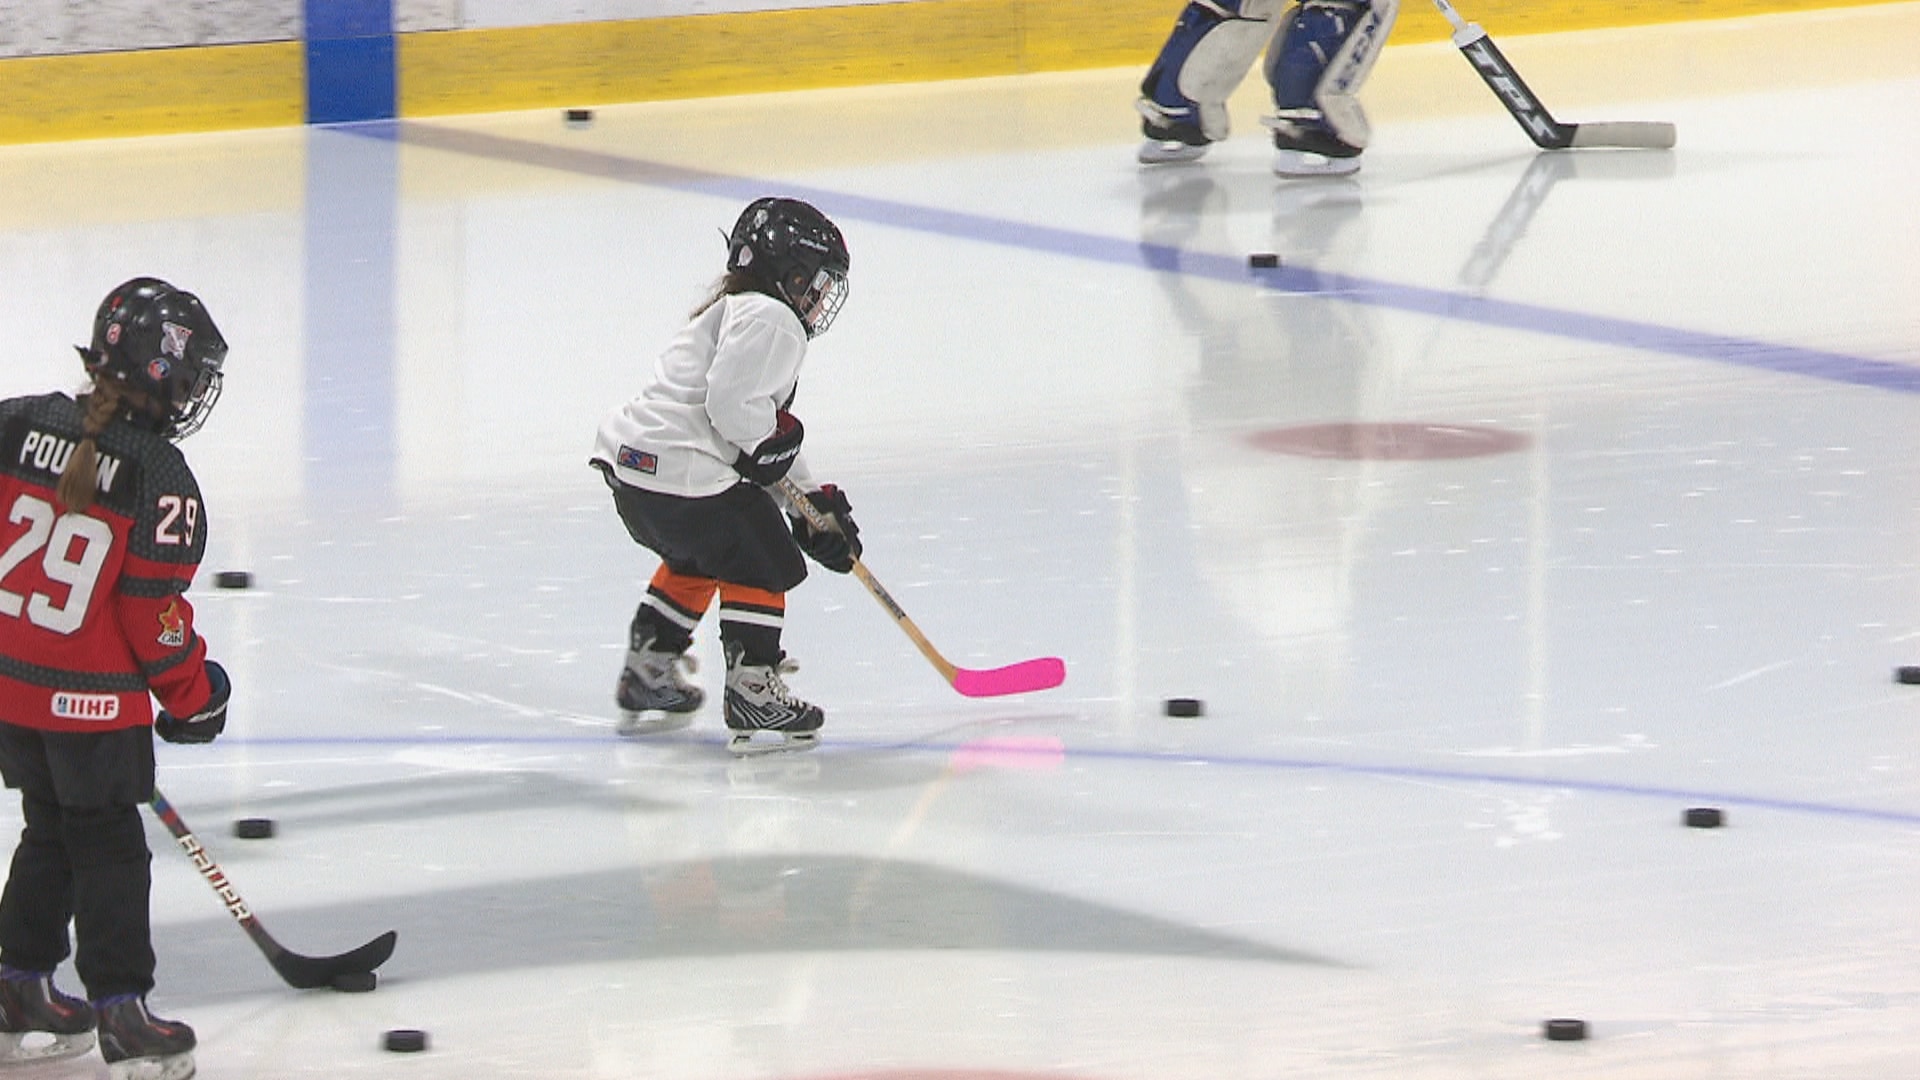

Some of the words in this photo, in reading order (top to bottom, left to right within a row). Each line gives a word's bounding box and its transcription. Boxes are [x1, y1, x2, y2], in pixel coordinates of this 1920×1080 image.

[19, 430, 121, 493] POUN
[155, 495, 197, 547] 29
[0, 493, 114, 635] 29
